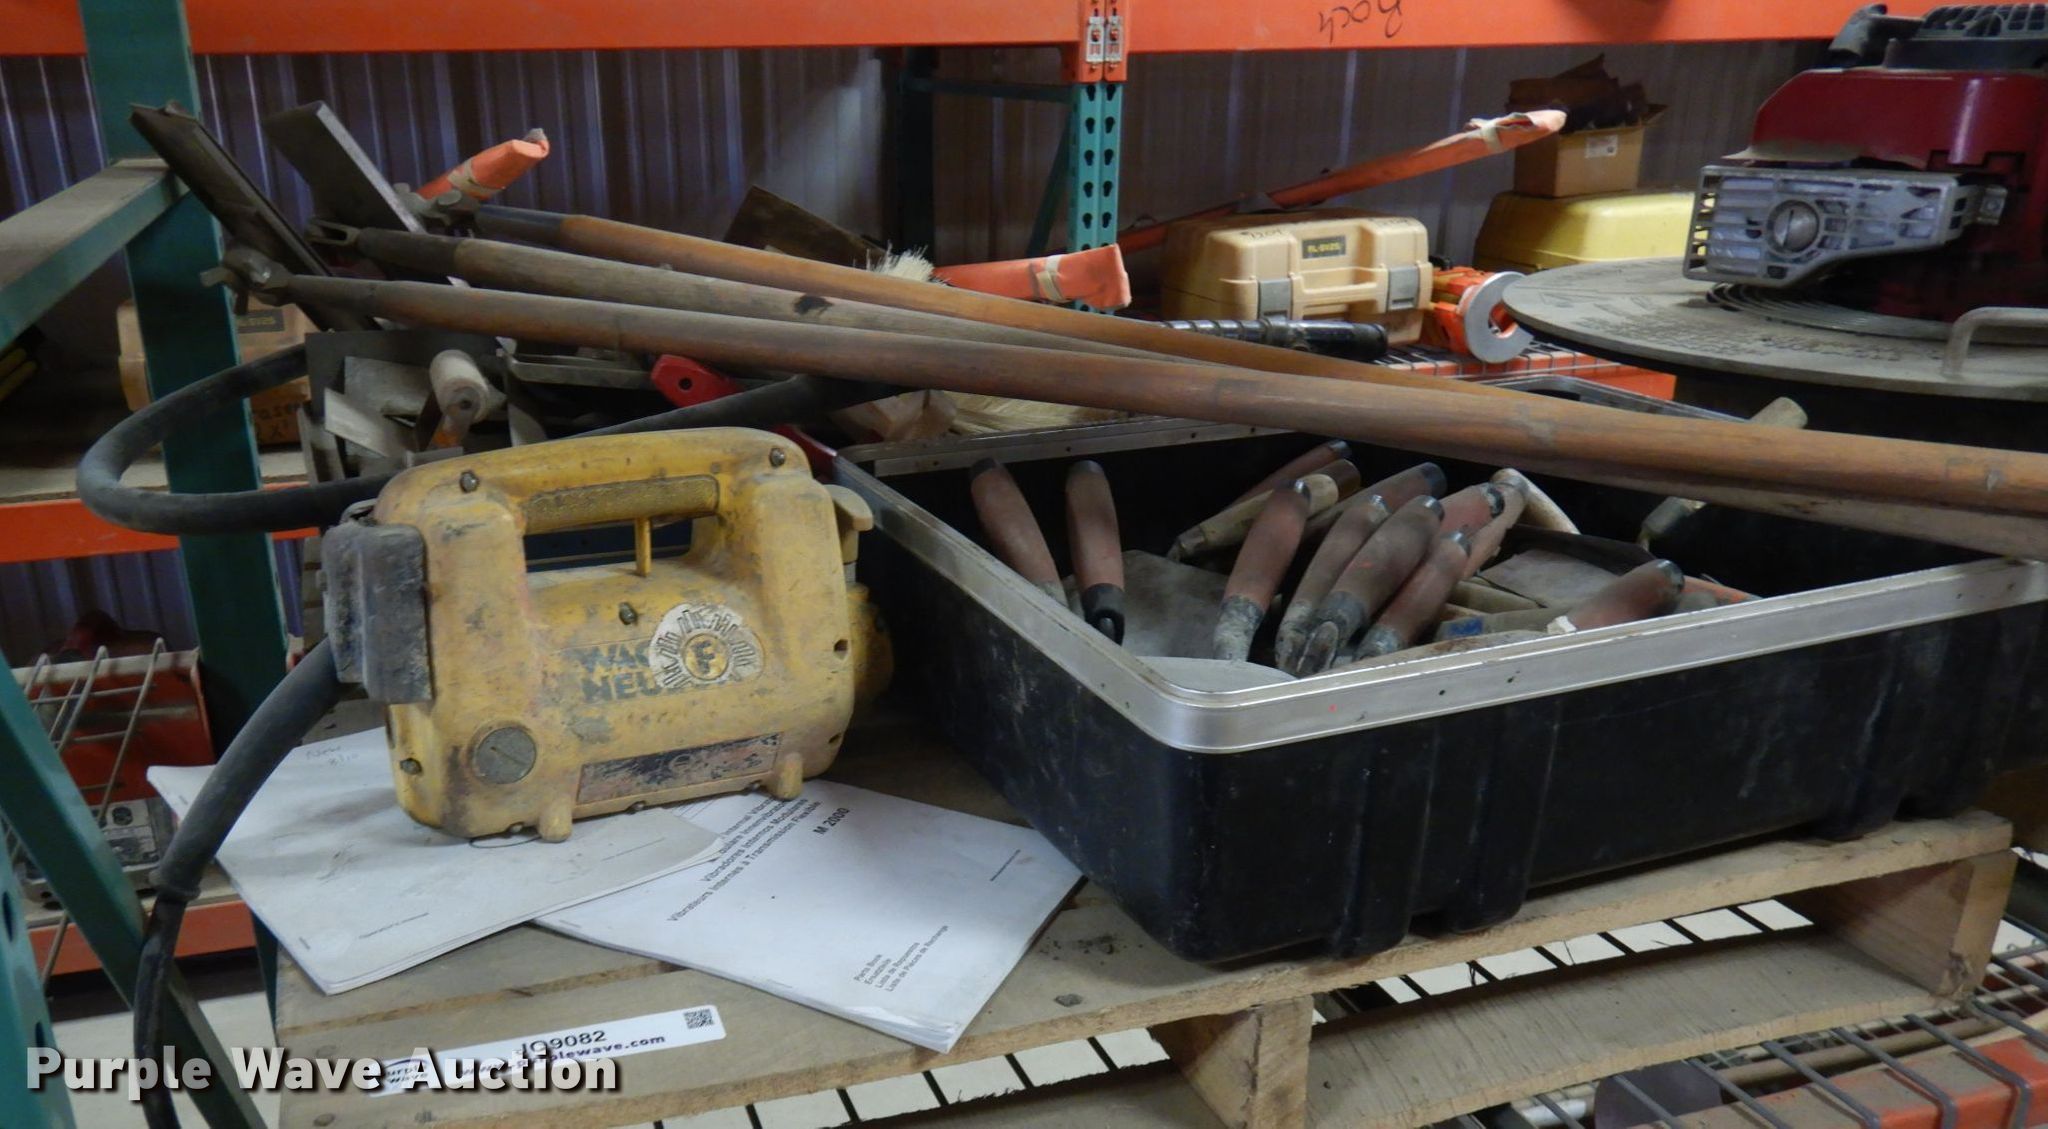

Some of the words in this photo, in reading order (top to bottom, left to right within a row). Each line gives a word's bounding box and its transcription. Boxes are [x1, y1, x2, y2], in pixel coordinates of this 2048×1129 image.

[812, 826, 828, 835] M
[823, 807, 850, 828] 2000
[749, 823, 796, 860] Transmission
